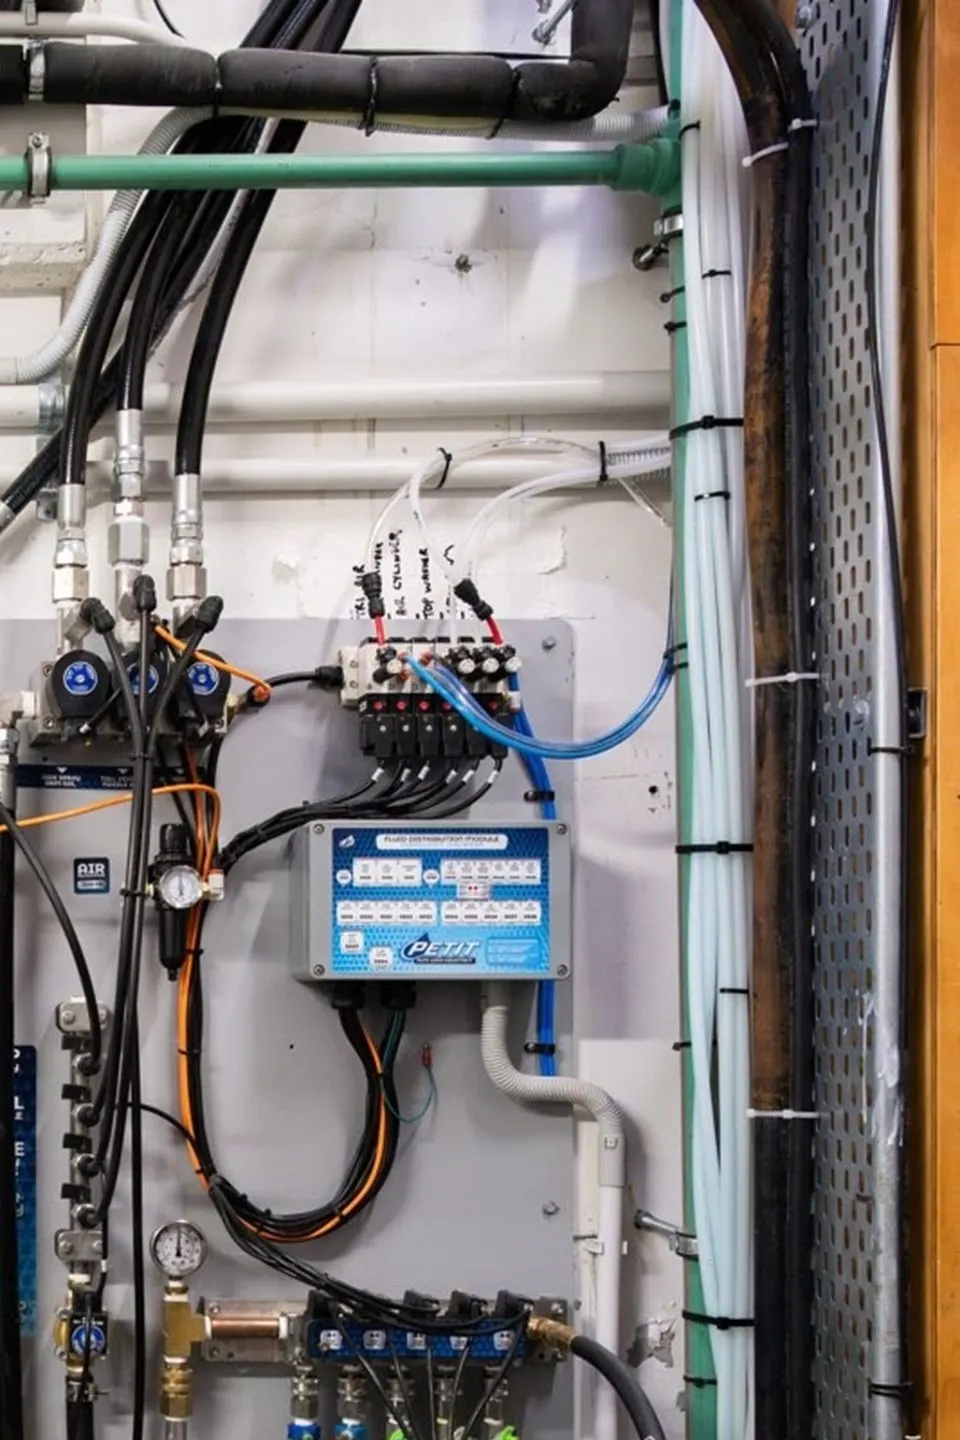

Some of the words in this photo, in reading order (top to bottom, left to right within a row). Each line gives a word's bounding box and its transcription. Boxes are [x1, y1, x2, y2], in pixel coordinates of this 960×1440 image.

[421, 597, 435, 620] TOP
[77, 863, 106, 877] AIR
[407, 941, 480, 956] PETIT
